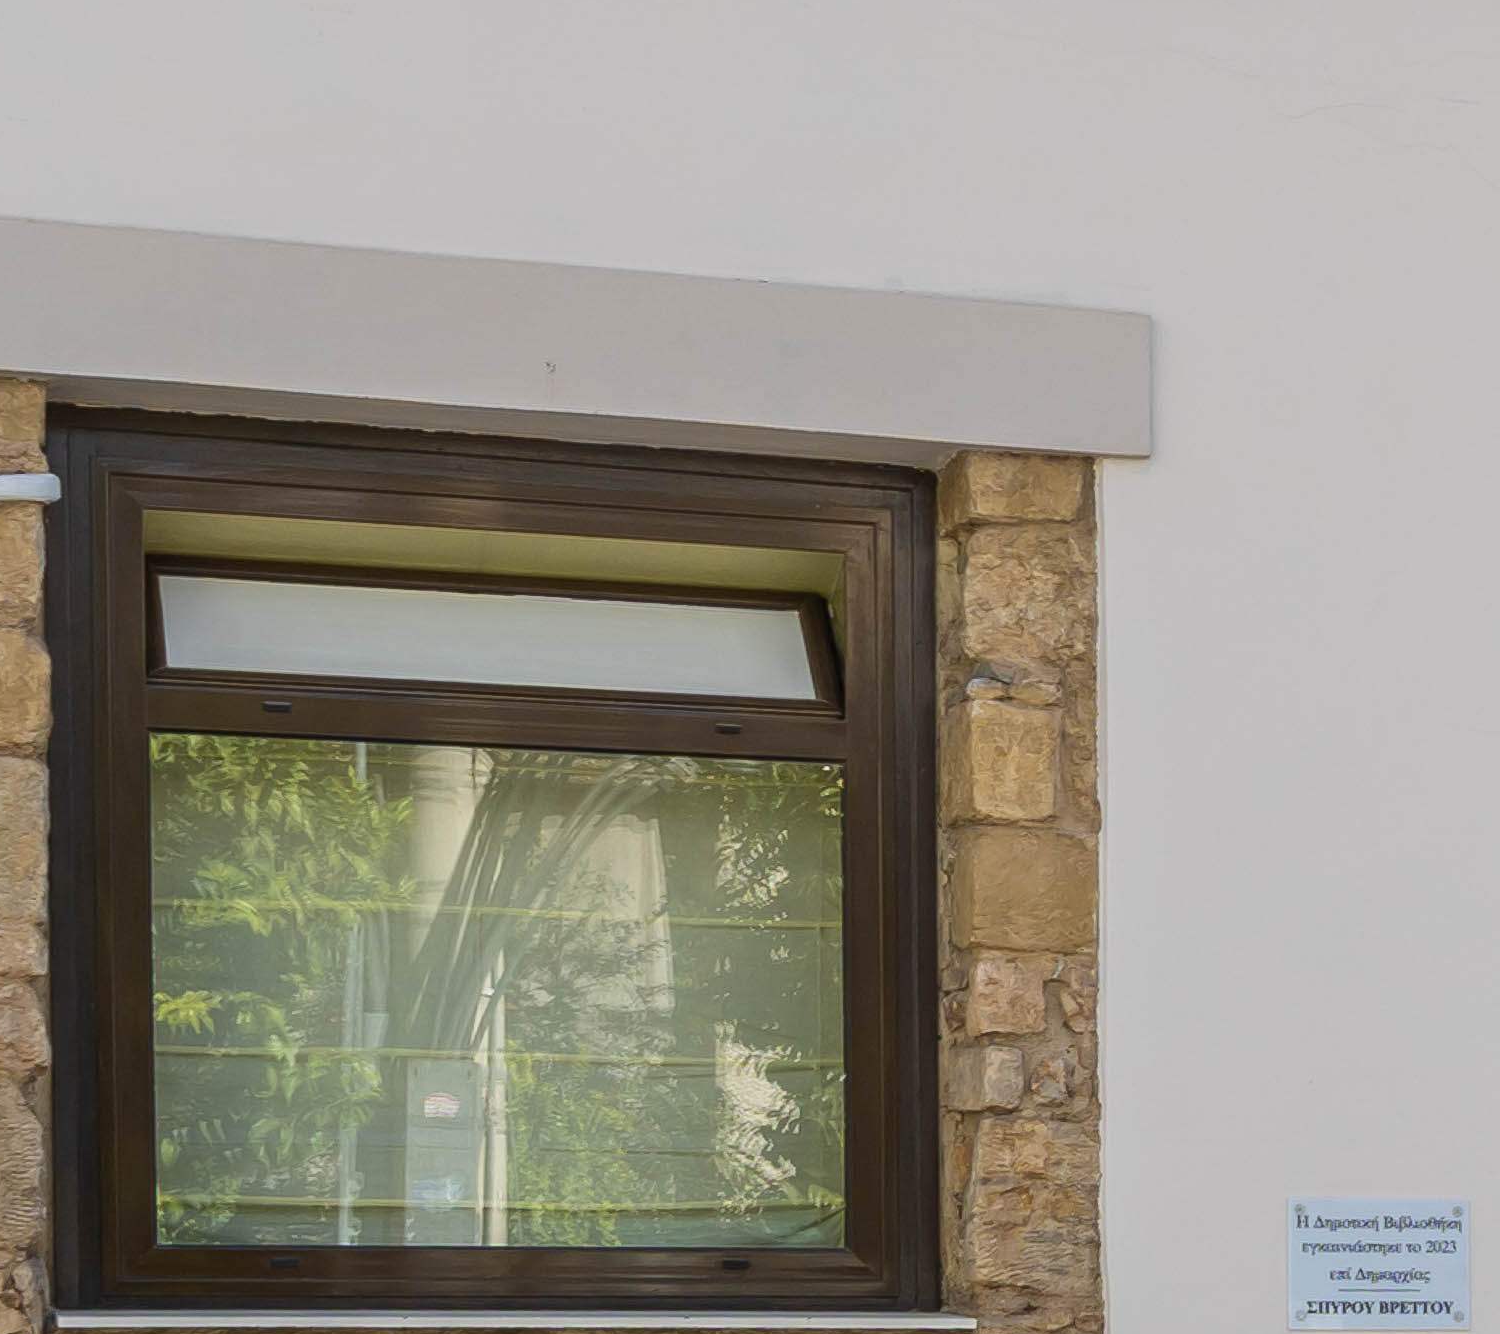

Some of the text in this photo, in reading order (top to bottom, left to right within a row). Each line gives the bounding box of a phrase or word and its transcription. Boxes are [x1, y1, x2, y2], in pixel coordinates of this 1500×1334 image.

[1296, 1215, 1309, 1229] Η
[1405, 1244, 1422, 1254] το
[1425, 1240, 1457, 1254] 2023
[1306, 1301, 1454, 1315] ΣΠΥΡΟΥ ΒΡΕΤΤΟΥ
